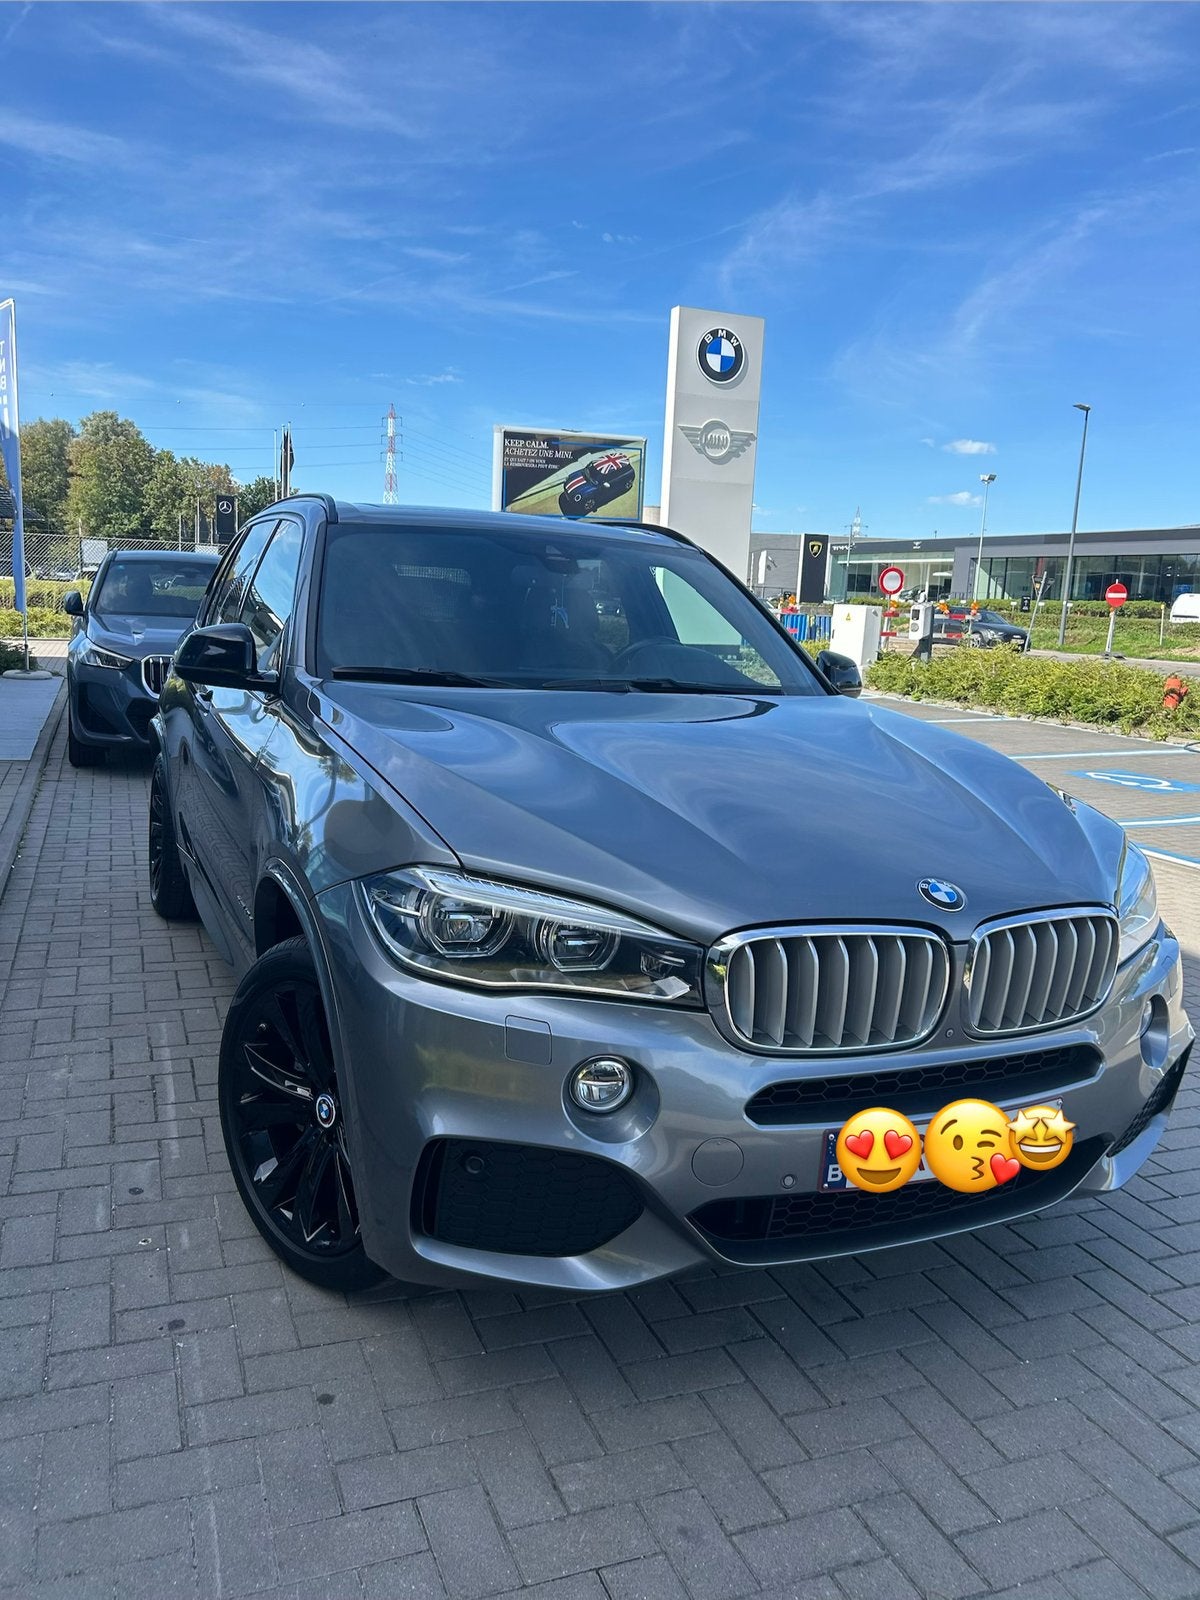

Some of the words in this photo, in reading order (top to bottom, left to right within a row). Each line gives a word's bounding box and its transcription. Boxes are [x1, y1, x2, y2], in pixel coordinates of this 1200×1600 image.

[704, 330, 739, 347] BMW
[504, 439, 525, 447] KEEP
[526, 440, 549, 449] CALM.
[504, 448, 538, 457] ACHETEZ
[538, 450, 554, 458] UNE
[554, 451, 573, 459] MINI.
[828, 1164, 843, 1182] B
